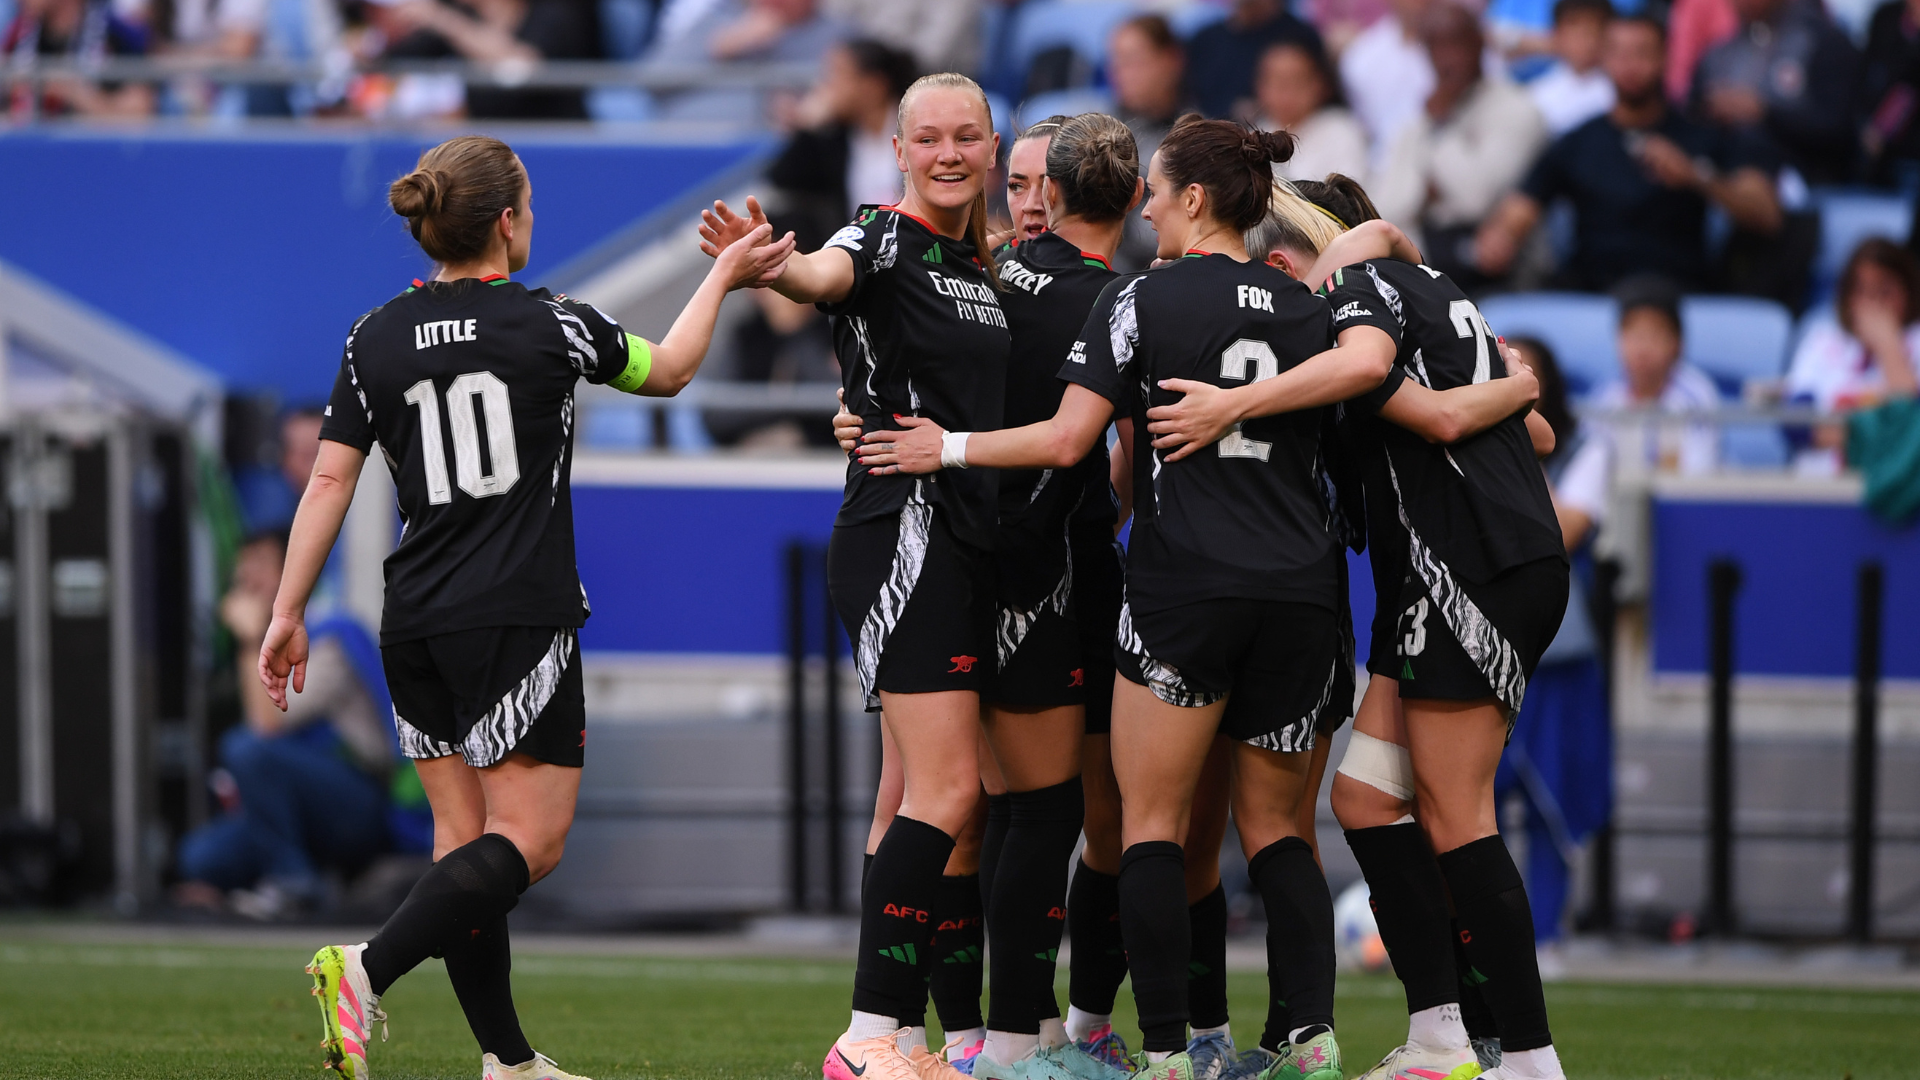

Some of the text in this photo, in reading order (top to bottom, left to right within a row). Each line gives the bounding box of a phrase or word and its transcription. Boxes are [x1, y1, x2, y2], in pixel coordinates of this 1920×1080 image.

[956, 299, 975, 321] FLY
[1237, 284, 1274, 314] FOX
[415, 318, 477, 350] LITTLE
[1217, 338, 1279, 463] 2
[403, 370, 521, 506] 10
[883, 903, 929, 924] AFC
